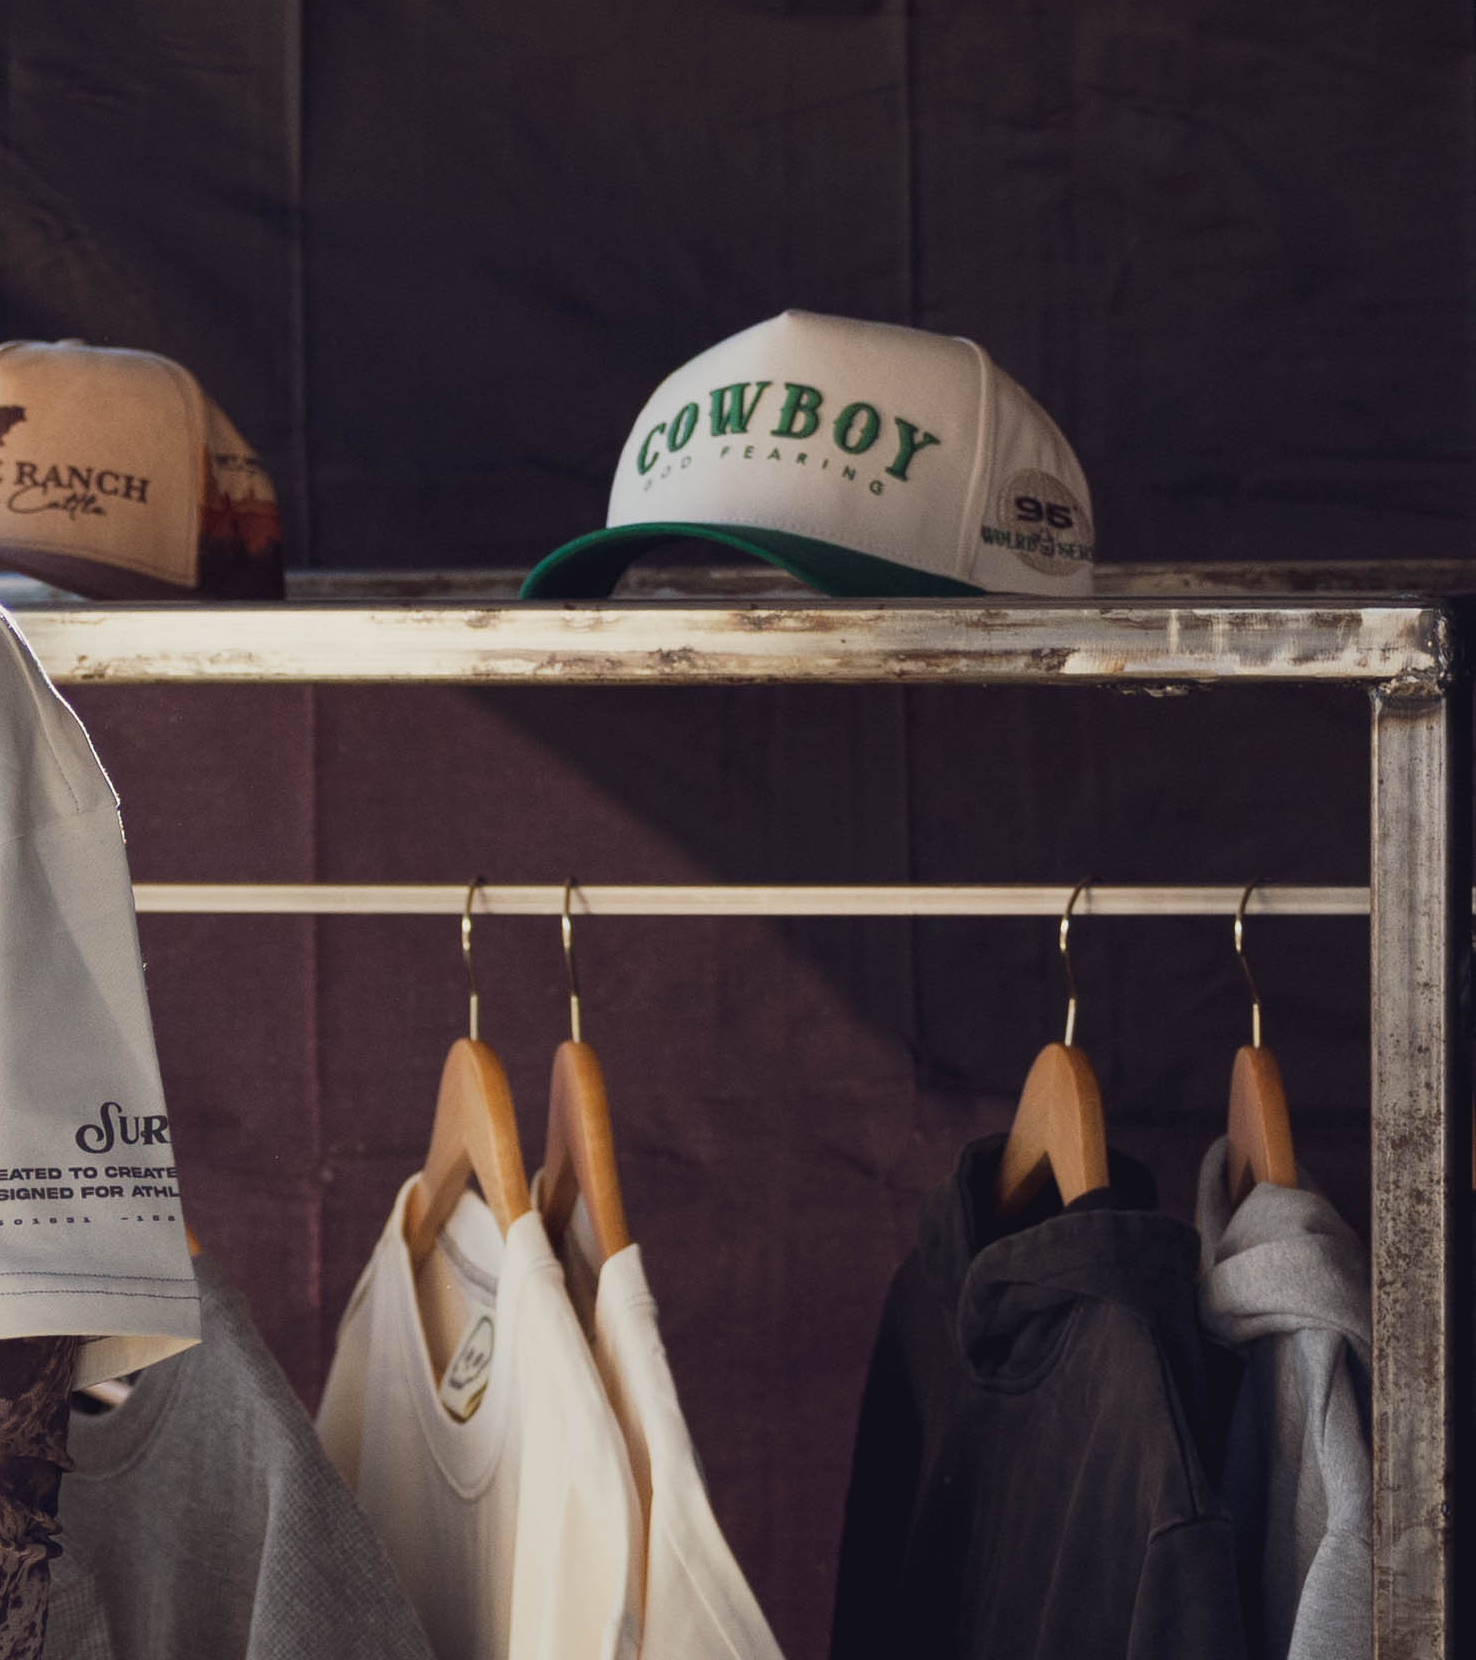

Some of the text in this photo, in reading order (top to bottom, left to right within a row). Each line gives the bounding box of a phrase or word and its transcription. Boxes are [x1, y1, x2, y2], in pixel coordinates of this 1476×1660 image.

[637, 381, 941, 482] COWBOY
[15, 461, 150, 503] RANCH
[721, 445, 883, 495] FEARING
[1015, 495, 1073, 529] 95
[68, 1166, 98, 1180] TO
[104, 1165, 178, 1179] CREATE
[80, 1185, 124, 1199] FOR
